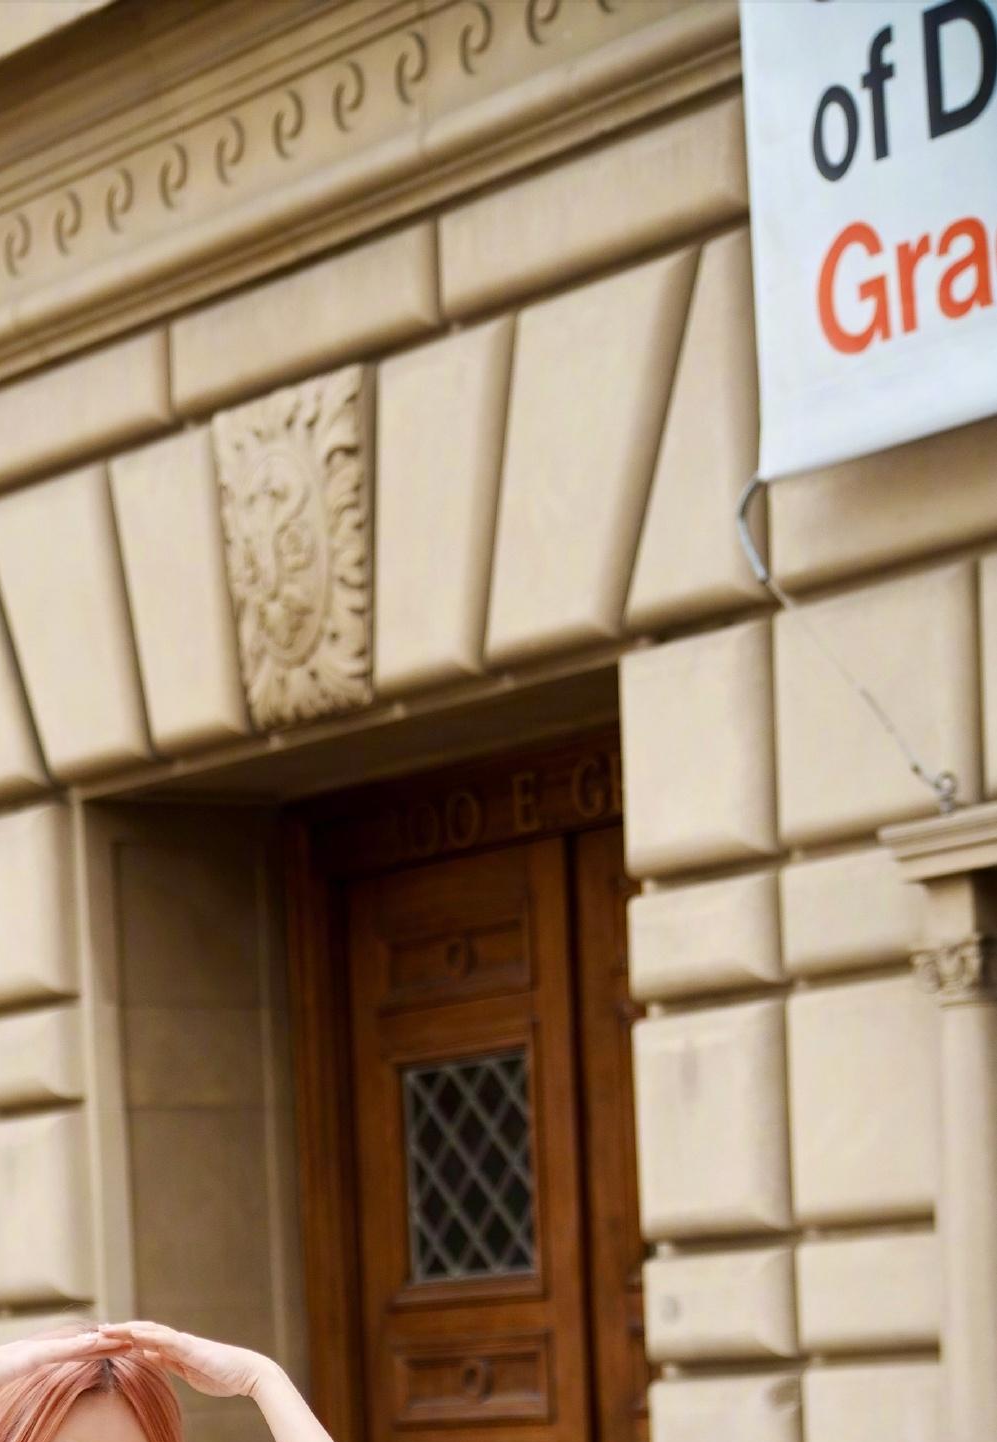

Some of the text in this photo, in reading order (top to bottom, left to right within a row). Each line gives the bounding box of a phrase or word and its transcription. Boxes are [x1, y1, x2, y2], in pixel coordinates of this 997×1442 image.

[812, 0, 997, 182] of D
[817, 217, 997, 355] Gra
